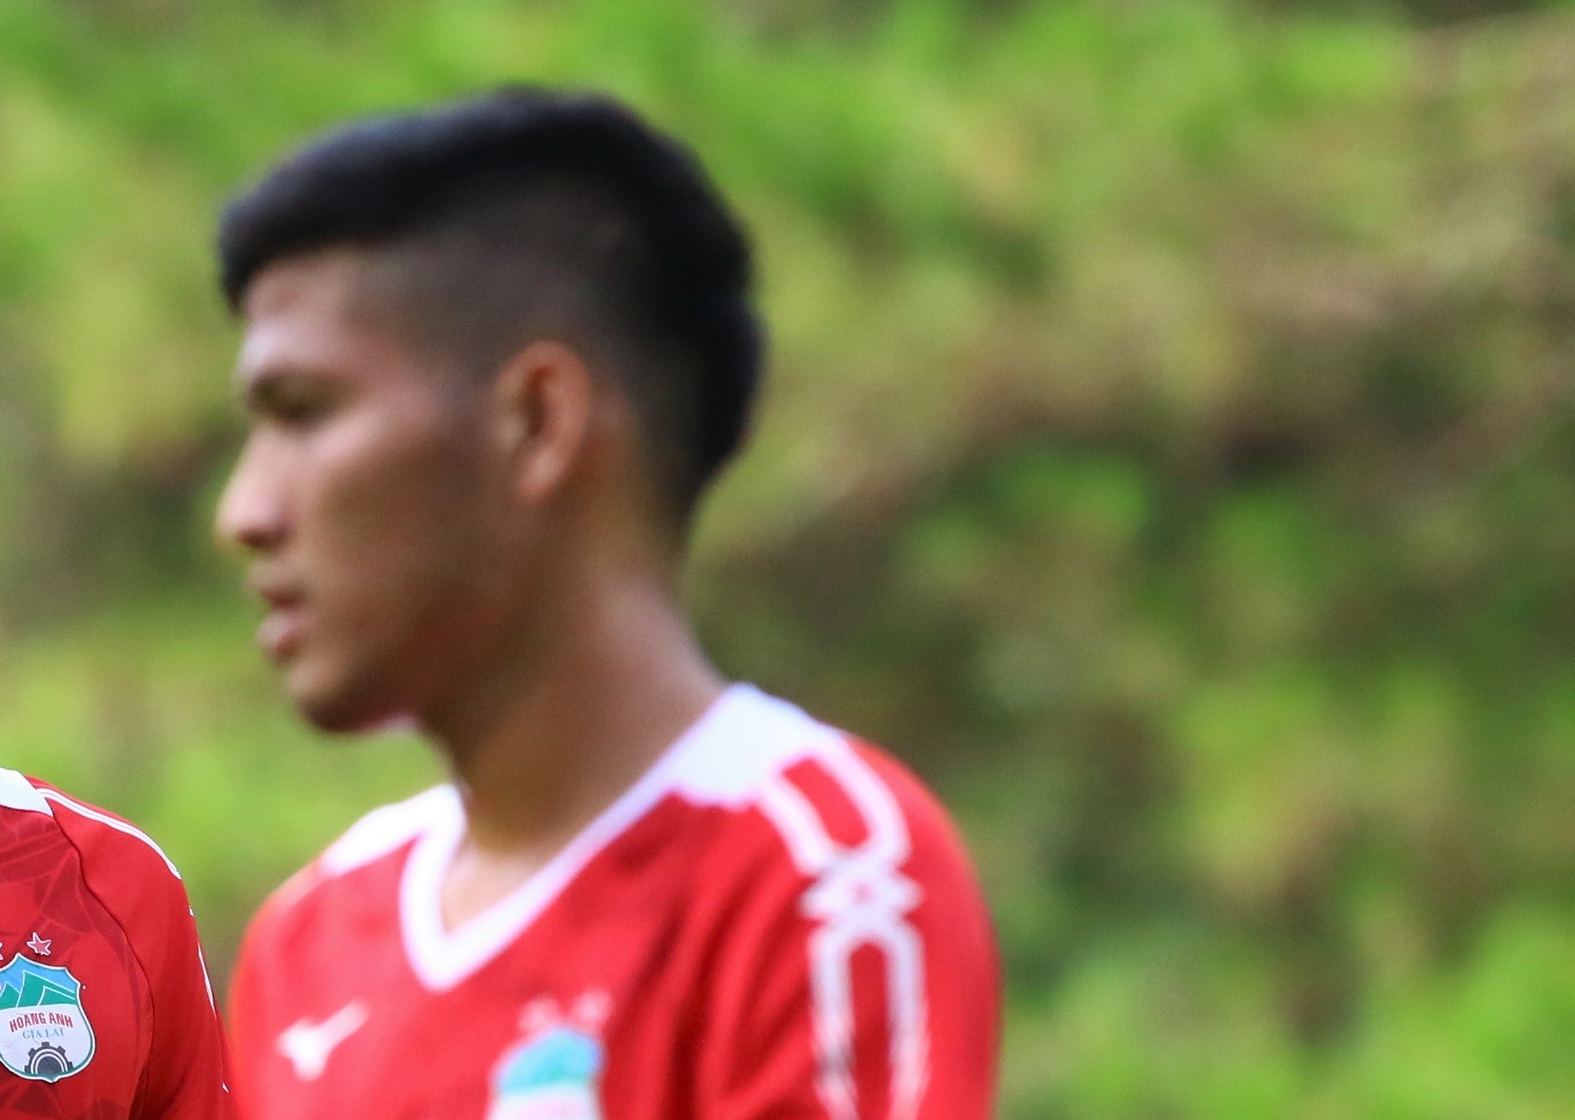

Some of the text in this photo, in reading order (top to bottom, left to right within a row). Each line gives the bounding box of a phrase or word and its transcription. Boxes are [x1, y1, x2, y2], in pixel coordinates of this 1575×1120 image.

[9, 1012, 74, 1033] HOANG ANH
[22, 1029, 43, 1039] GIA
